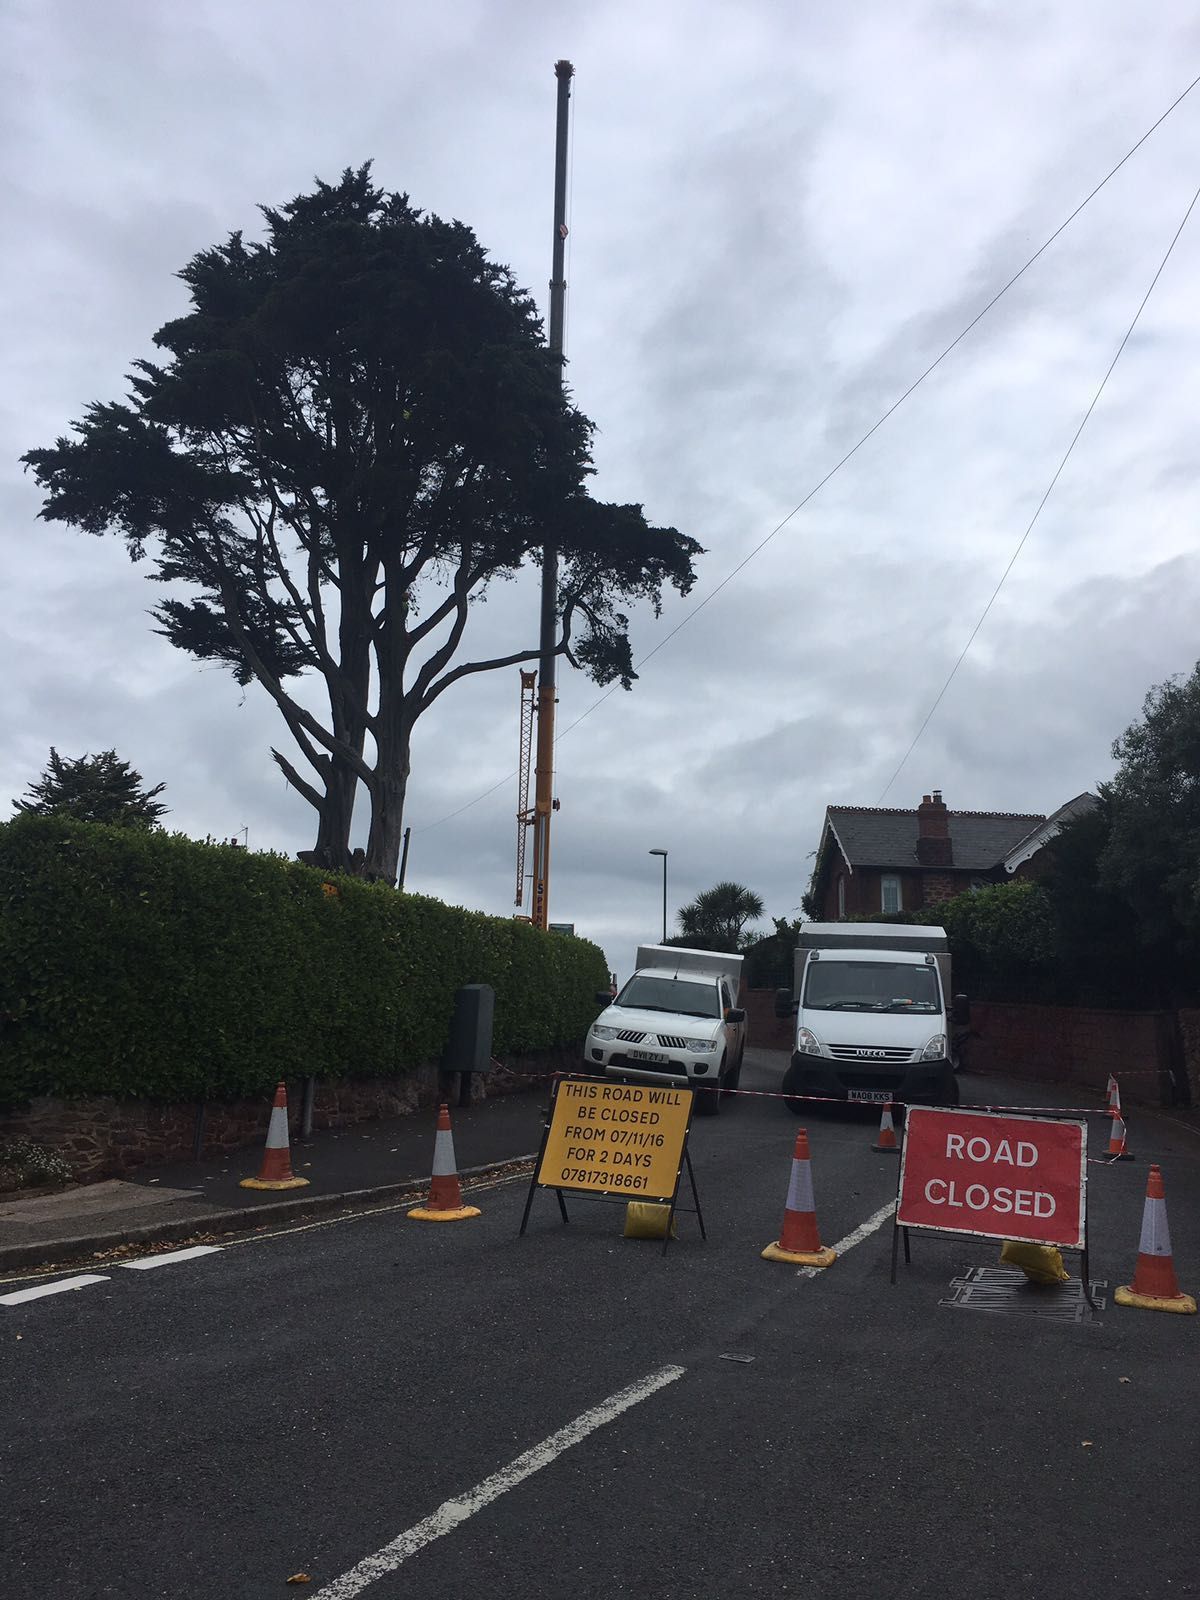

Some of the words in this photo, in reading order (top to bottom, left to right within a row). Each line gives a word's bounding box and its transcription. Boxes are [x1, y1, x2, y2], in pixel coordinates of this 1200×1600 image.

[856, 1048, 886, 1057] IVECO
[565, 1084, 598, 1099] THIS
[602, 1088, 643, 1102] ROAD
[648, 1092, 682, 1106] WILL
[874, 1092, 890, 1101] KKS
[578, 1106, 596, 1120] BE
[601, 1108, 660, 1125] CLOSED
[564, 1126, 606, 1141] FROM
[610, 1130, 664, 1148] 07/11/16
[566, 1147, 594, 1162] FOR
[599, 1150, 608, 1163] 2
[613, 1152, 652, 1168] DAYS
[945, 1133, 1039, 1168] ROAD
[561, 1168, 648, 1190] 07817318661
[924, 1178, 1057, 1219] CLOSED
